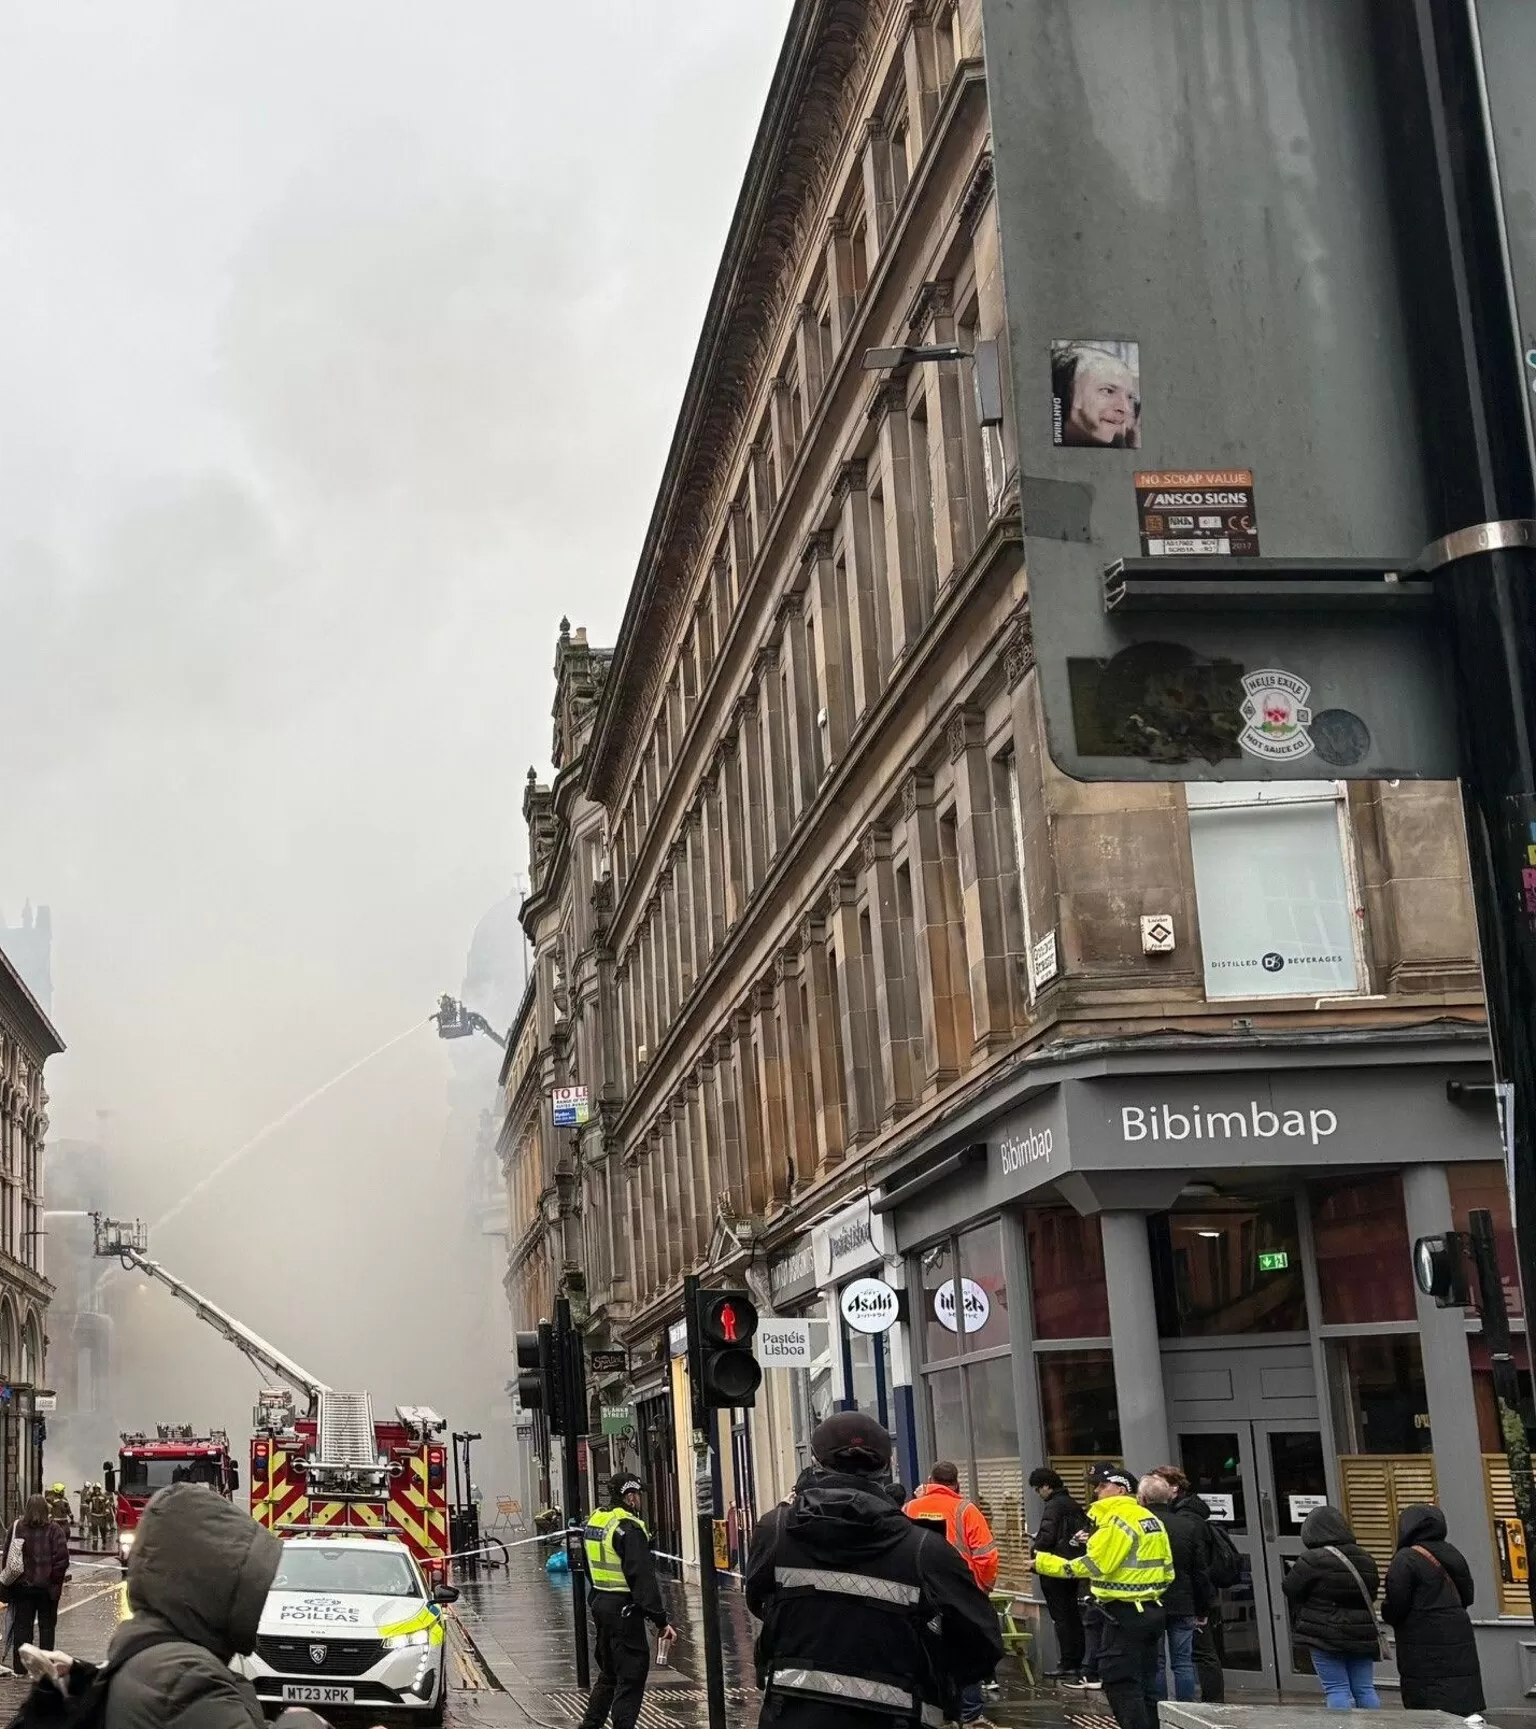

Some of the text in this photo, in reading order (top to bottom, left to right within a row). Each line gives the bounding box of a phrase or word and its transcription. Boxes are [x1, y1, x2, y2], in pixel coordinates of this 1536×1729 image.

[1141, 473, 1246, 485] NO SCRAP VALUE
[1154, 493, 1247, 504] ANSCO SIGNS
[1248, 676, 1303, 695] HELLS EXILE
[1246, 734, 1263, 748] HOT
[1264, 744, 1292, 753] SAUCE
[1211, 960, 1257, 968] DISTILLED
[1288, 955, 1343, 964] BEVERAGES
[554, 1089, 570, 1100] TO
[1122, 1101, 1338, 1145] Bibimbap
[1000, 1127, 1053, 1175] Bibimbap
[848, 1293, 892, 1312] Asahi
[762, 1330, 805, 1344] Pastéis
[765, 1344, 805, 1355] Lisboa
[282, 1605, 359, 1615] POLICE
[281, 1612, 359, 1623] POILEAS
[287, 1687, 348, 1701] MT23 XPK
